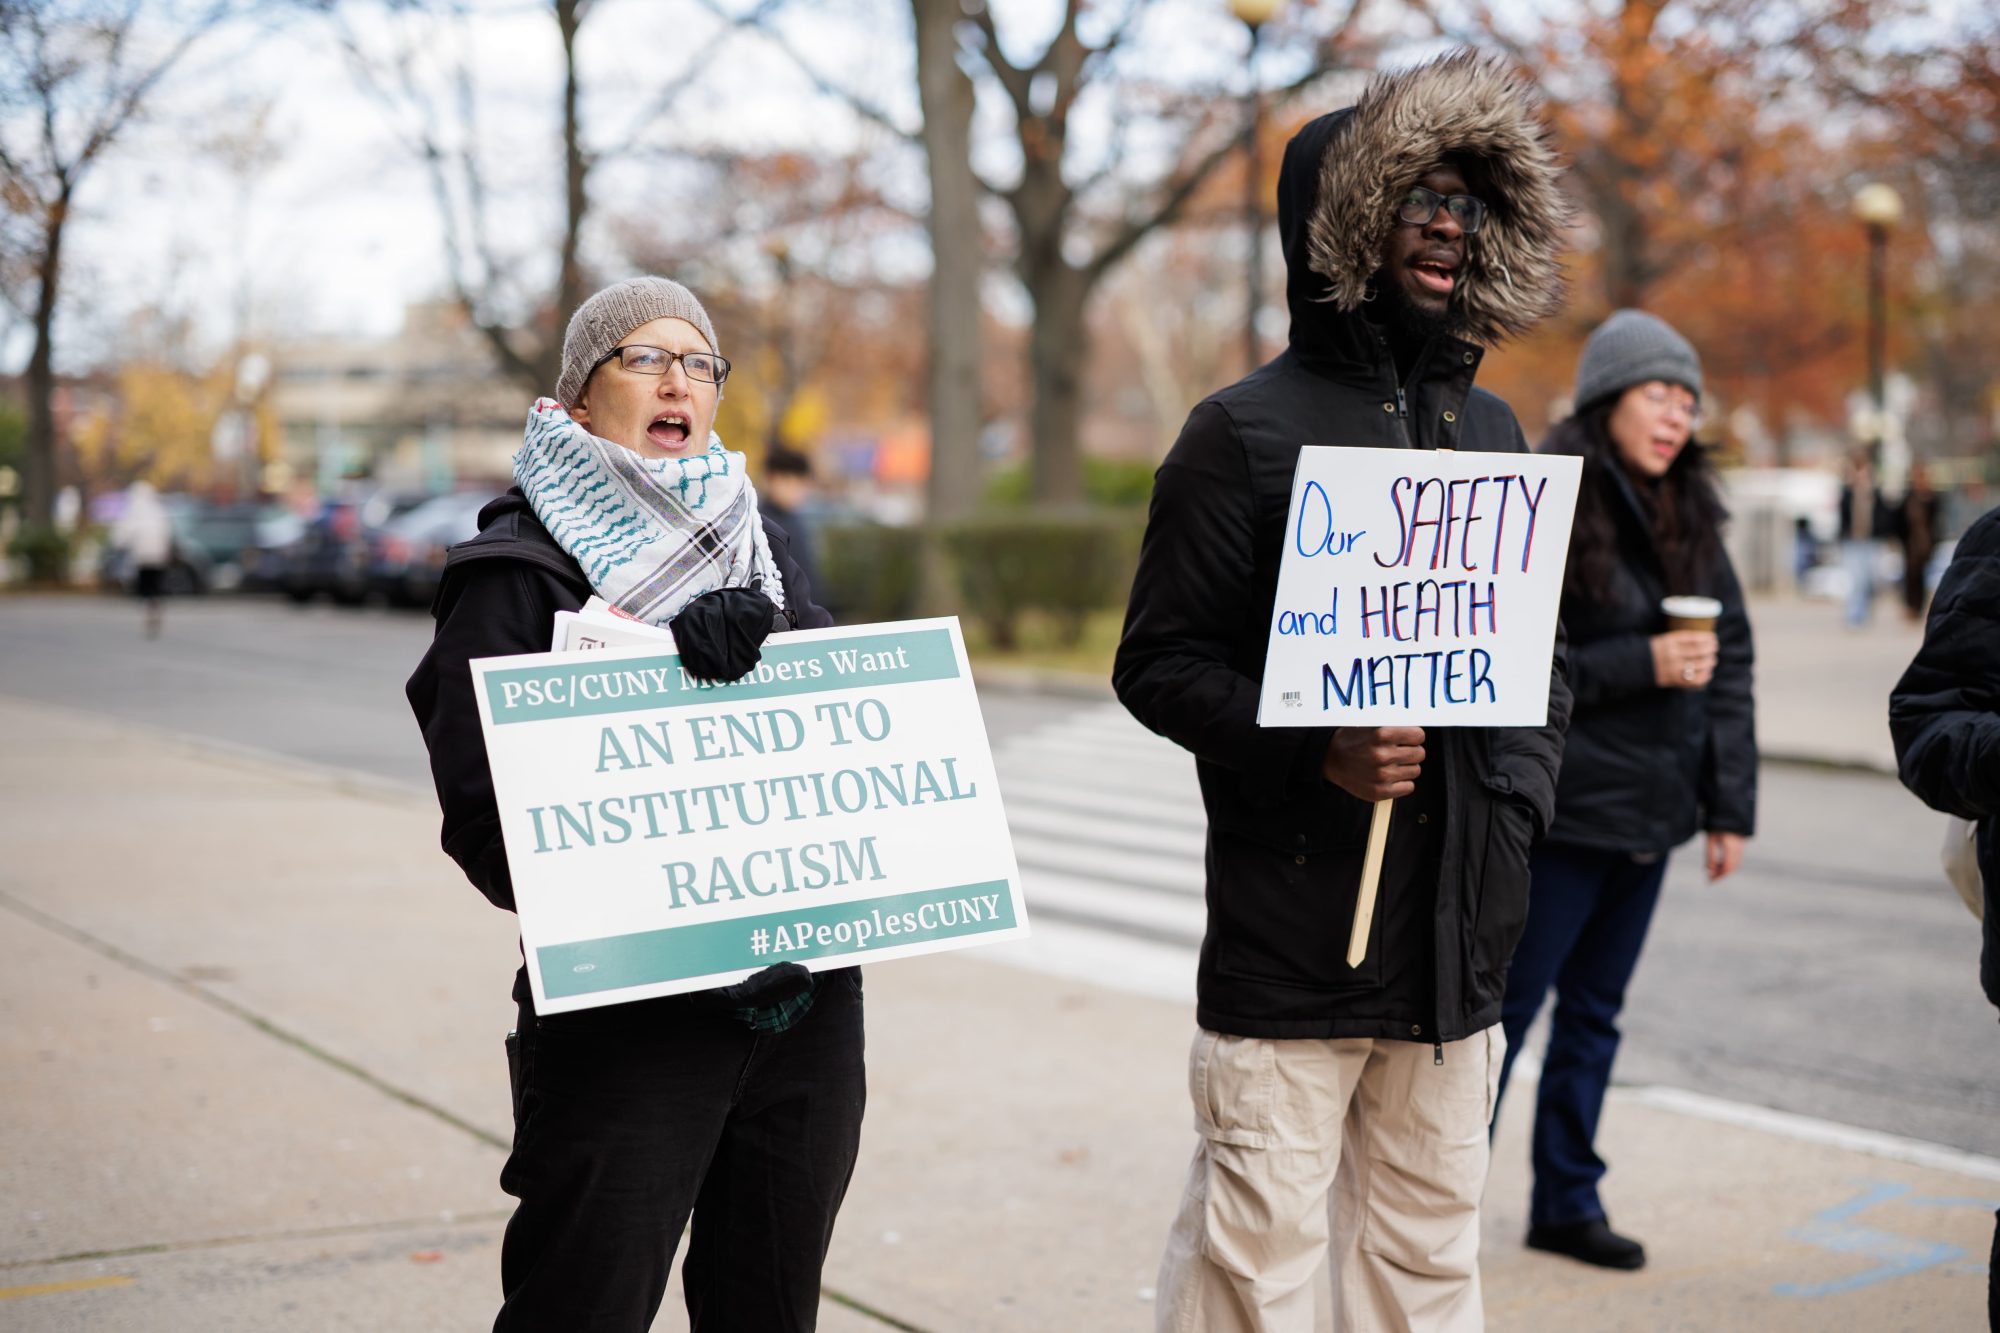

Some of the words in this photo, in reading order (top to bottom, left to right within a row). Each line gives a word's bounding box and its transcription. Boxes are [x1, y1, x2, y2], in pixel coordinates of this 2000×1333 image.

[1296, 480, 1366, 557] Our
[1373, 474, 1548, 575] SAFETY
[1277, 586, 1338, 636] and
[1360, 578, 1497, 642] HEATH
[500, 667, 669, 708] PSC/CUNY
[827, 646, 910, 675] Want
[1321, 648, 1497, 711] MATTER
[594, 720, 674, 773] AN
[685, 708, 805, 762] END
[814, 698, 891, 746] TO
[526, 757, 977, 854] INSTITUTIONAL
[661, 836, 887, 910] RACISM
[750, 893, 1000, 956] #APeoplesCUNY
